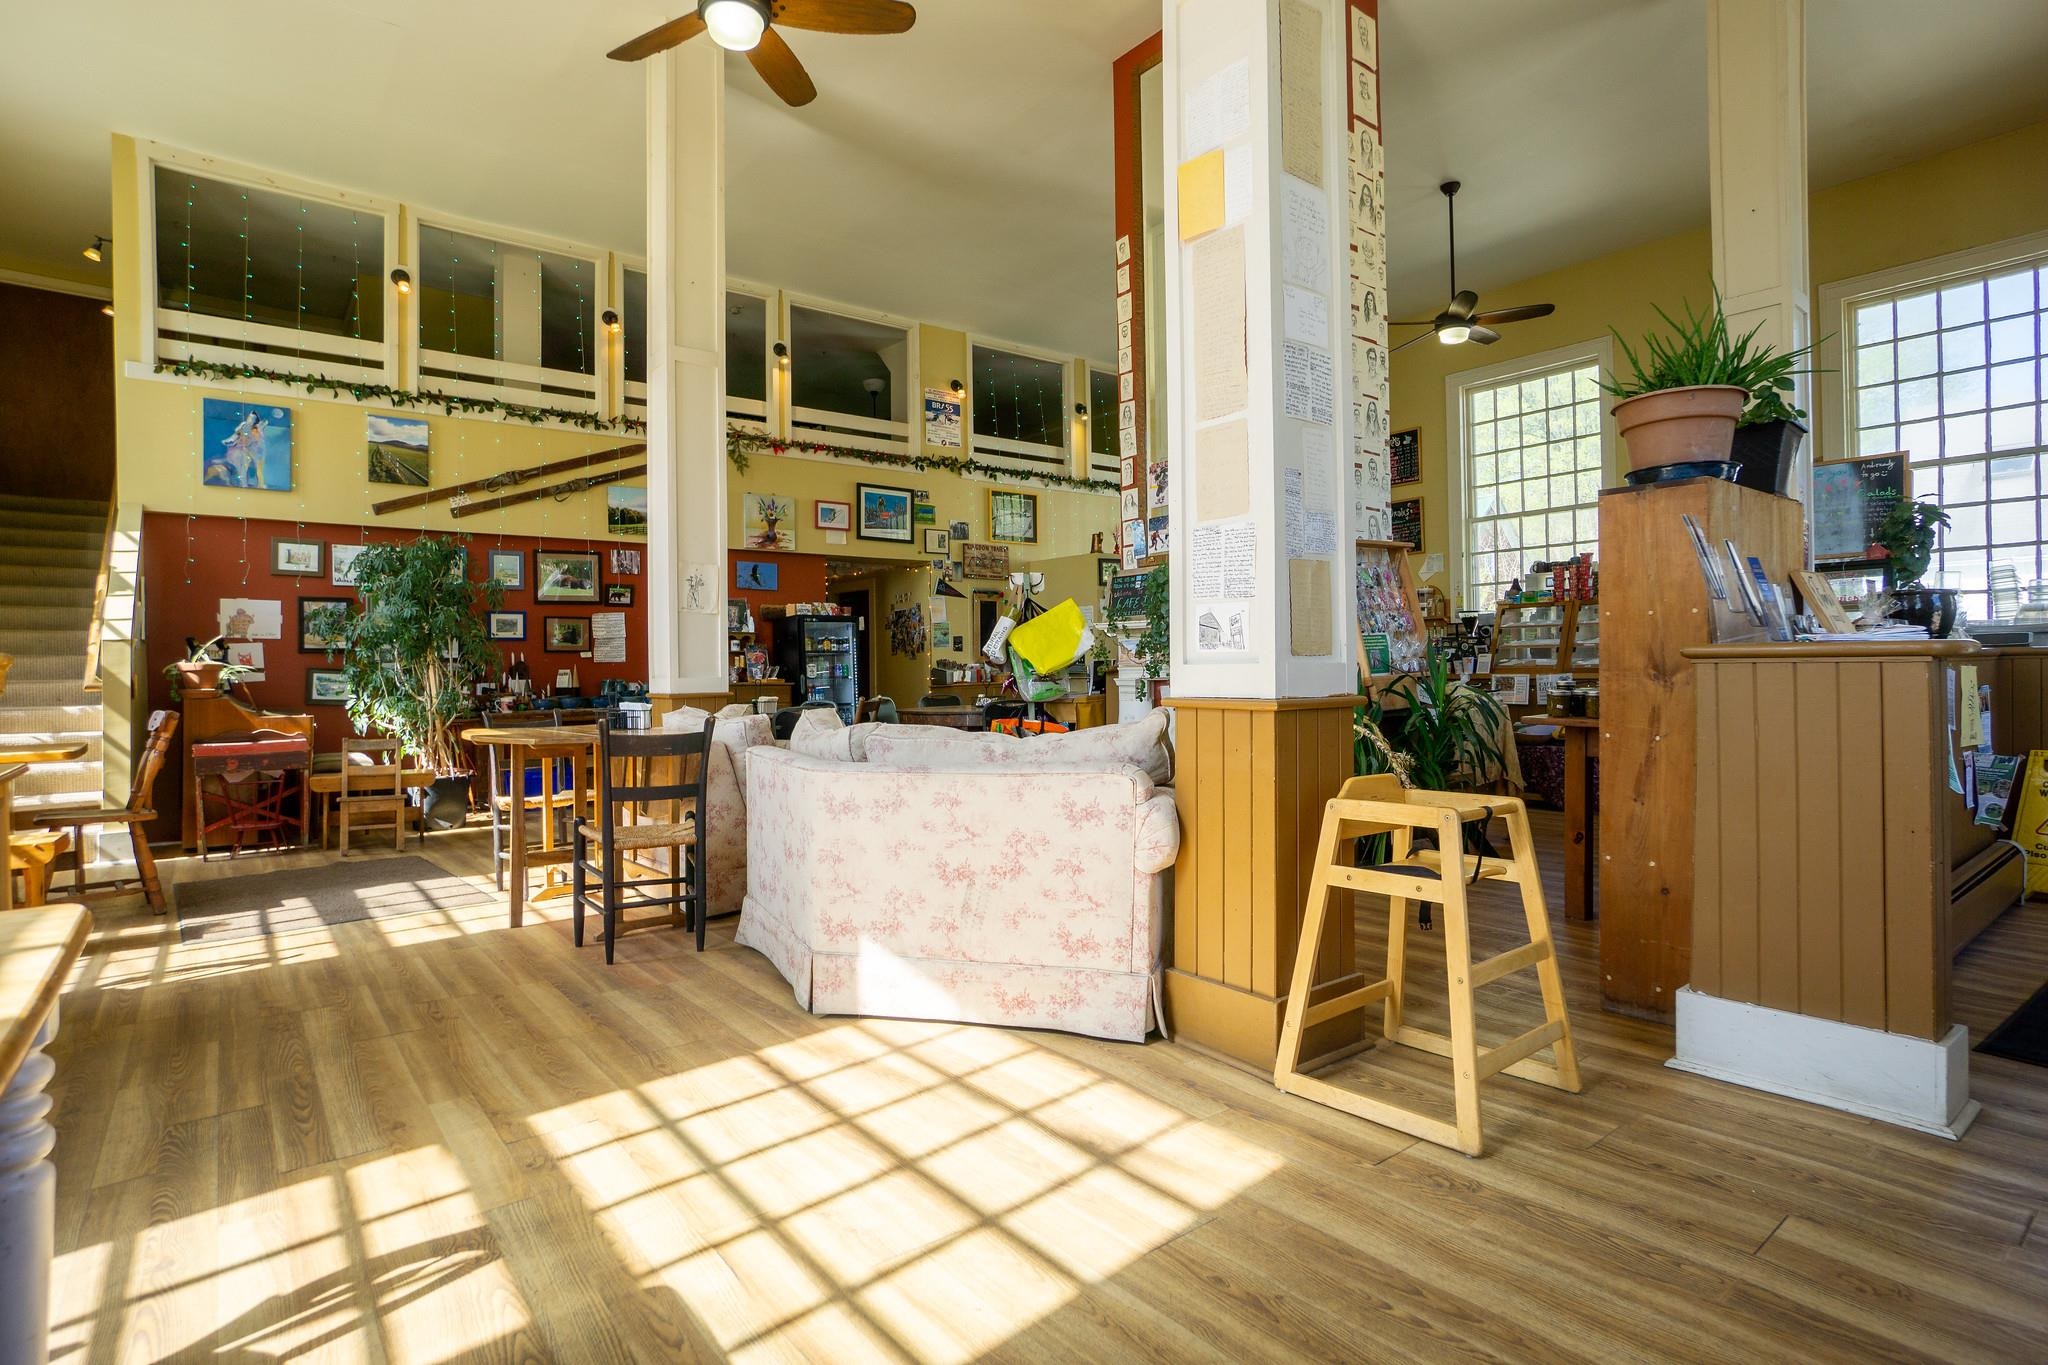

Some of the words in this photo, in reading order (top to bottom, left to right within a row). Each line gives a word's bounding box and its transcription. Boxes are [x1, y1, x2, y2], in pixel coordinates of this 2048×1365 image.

[931, 401, 954, 413] BRASS
[1870, 472, 1880, 480] go
[1857, 486, 1897, 498] Salads
